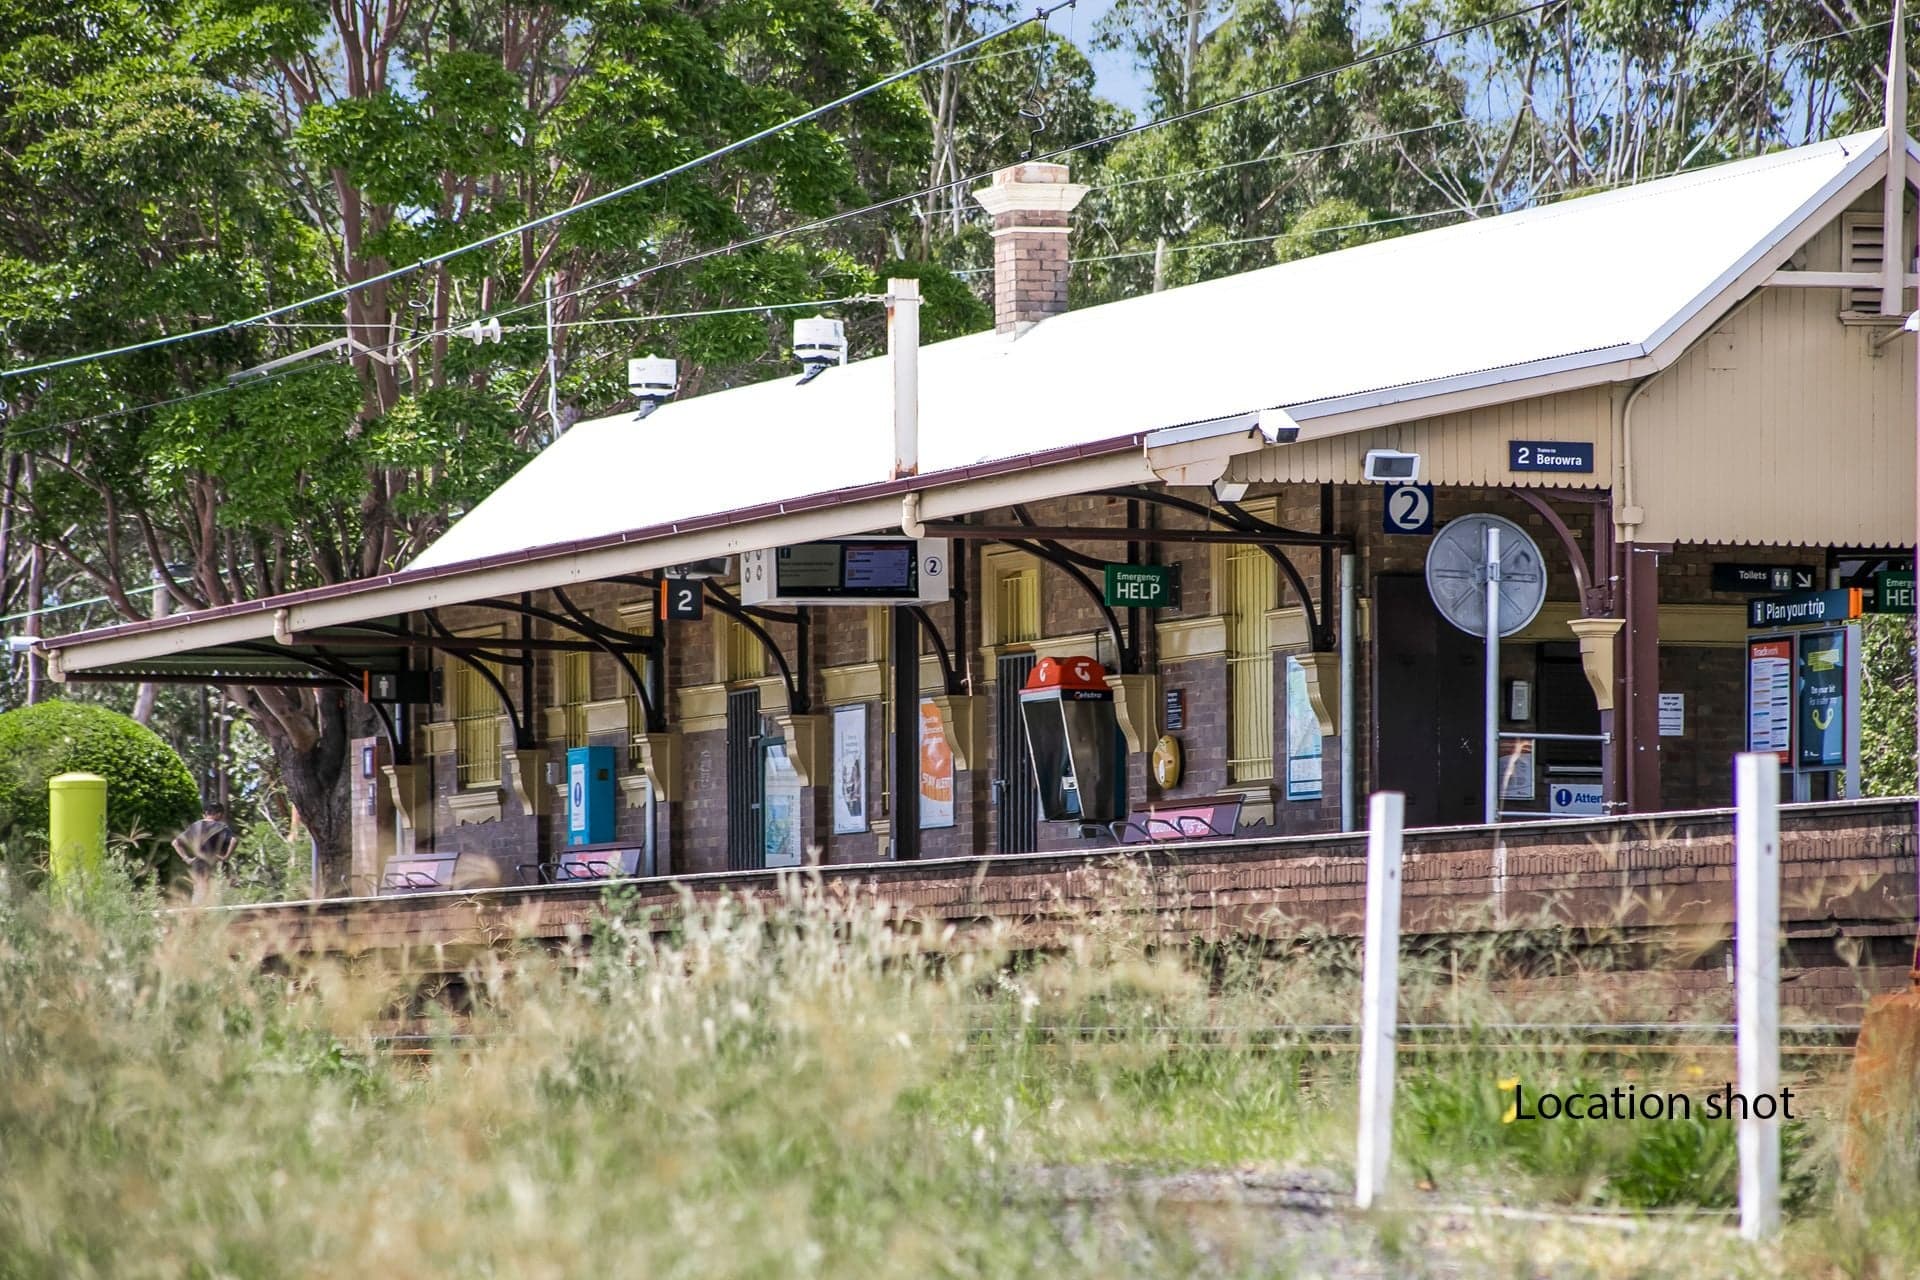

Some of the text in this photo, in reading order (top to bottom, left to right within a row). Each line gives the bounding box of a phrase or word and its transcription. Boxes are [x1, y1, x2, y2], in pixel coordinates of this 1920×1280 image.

[1517, 447, 1530, 464] 2
[1536, 454, 1583, 466] Berowra
[1399, 490, 1420, 524] 2
[929, 559, 938, 573] 2
[1116, 572, 1161, 583] Emergency
[1738, 570, 1767, 580] Toilets
[1116, 582, 1161, 600] HELP
[678, 589, 692, 611] 2
[1766, 602, 1786, 620] Plan
[1786, 602, 1809, 622] your
[1808, 598, 1825, 619] trip
